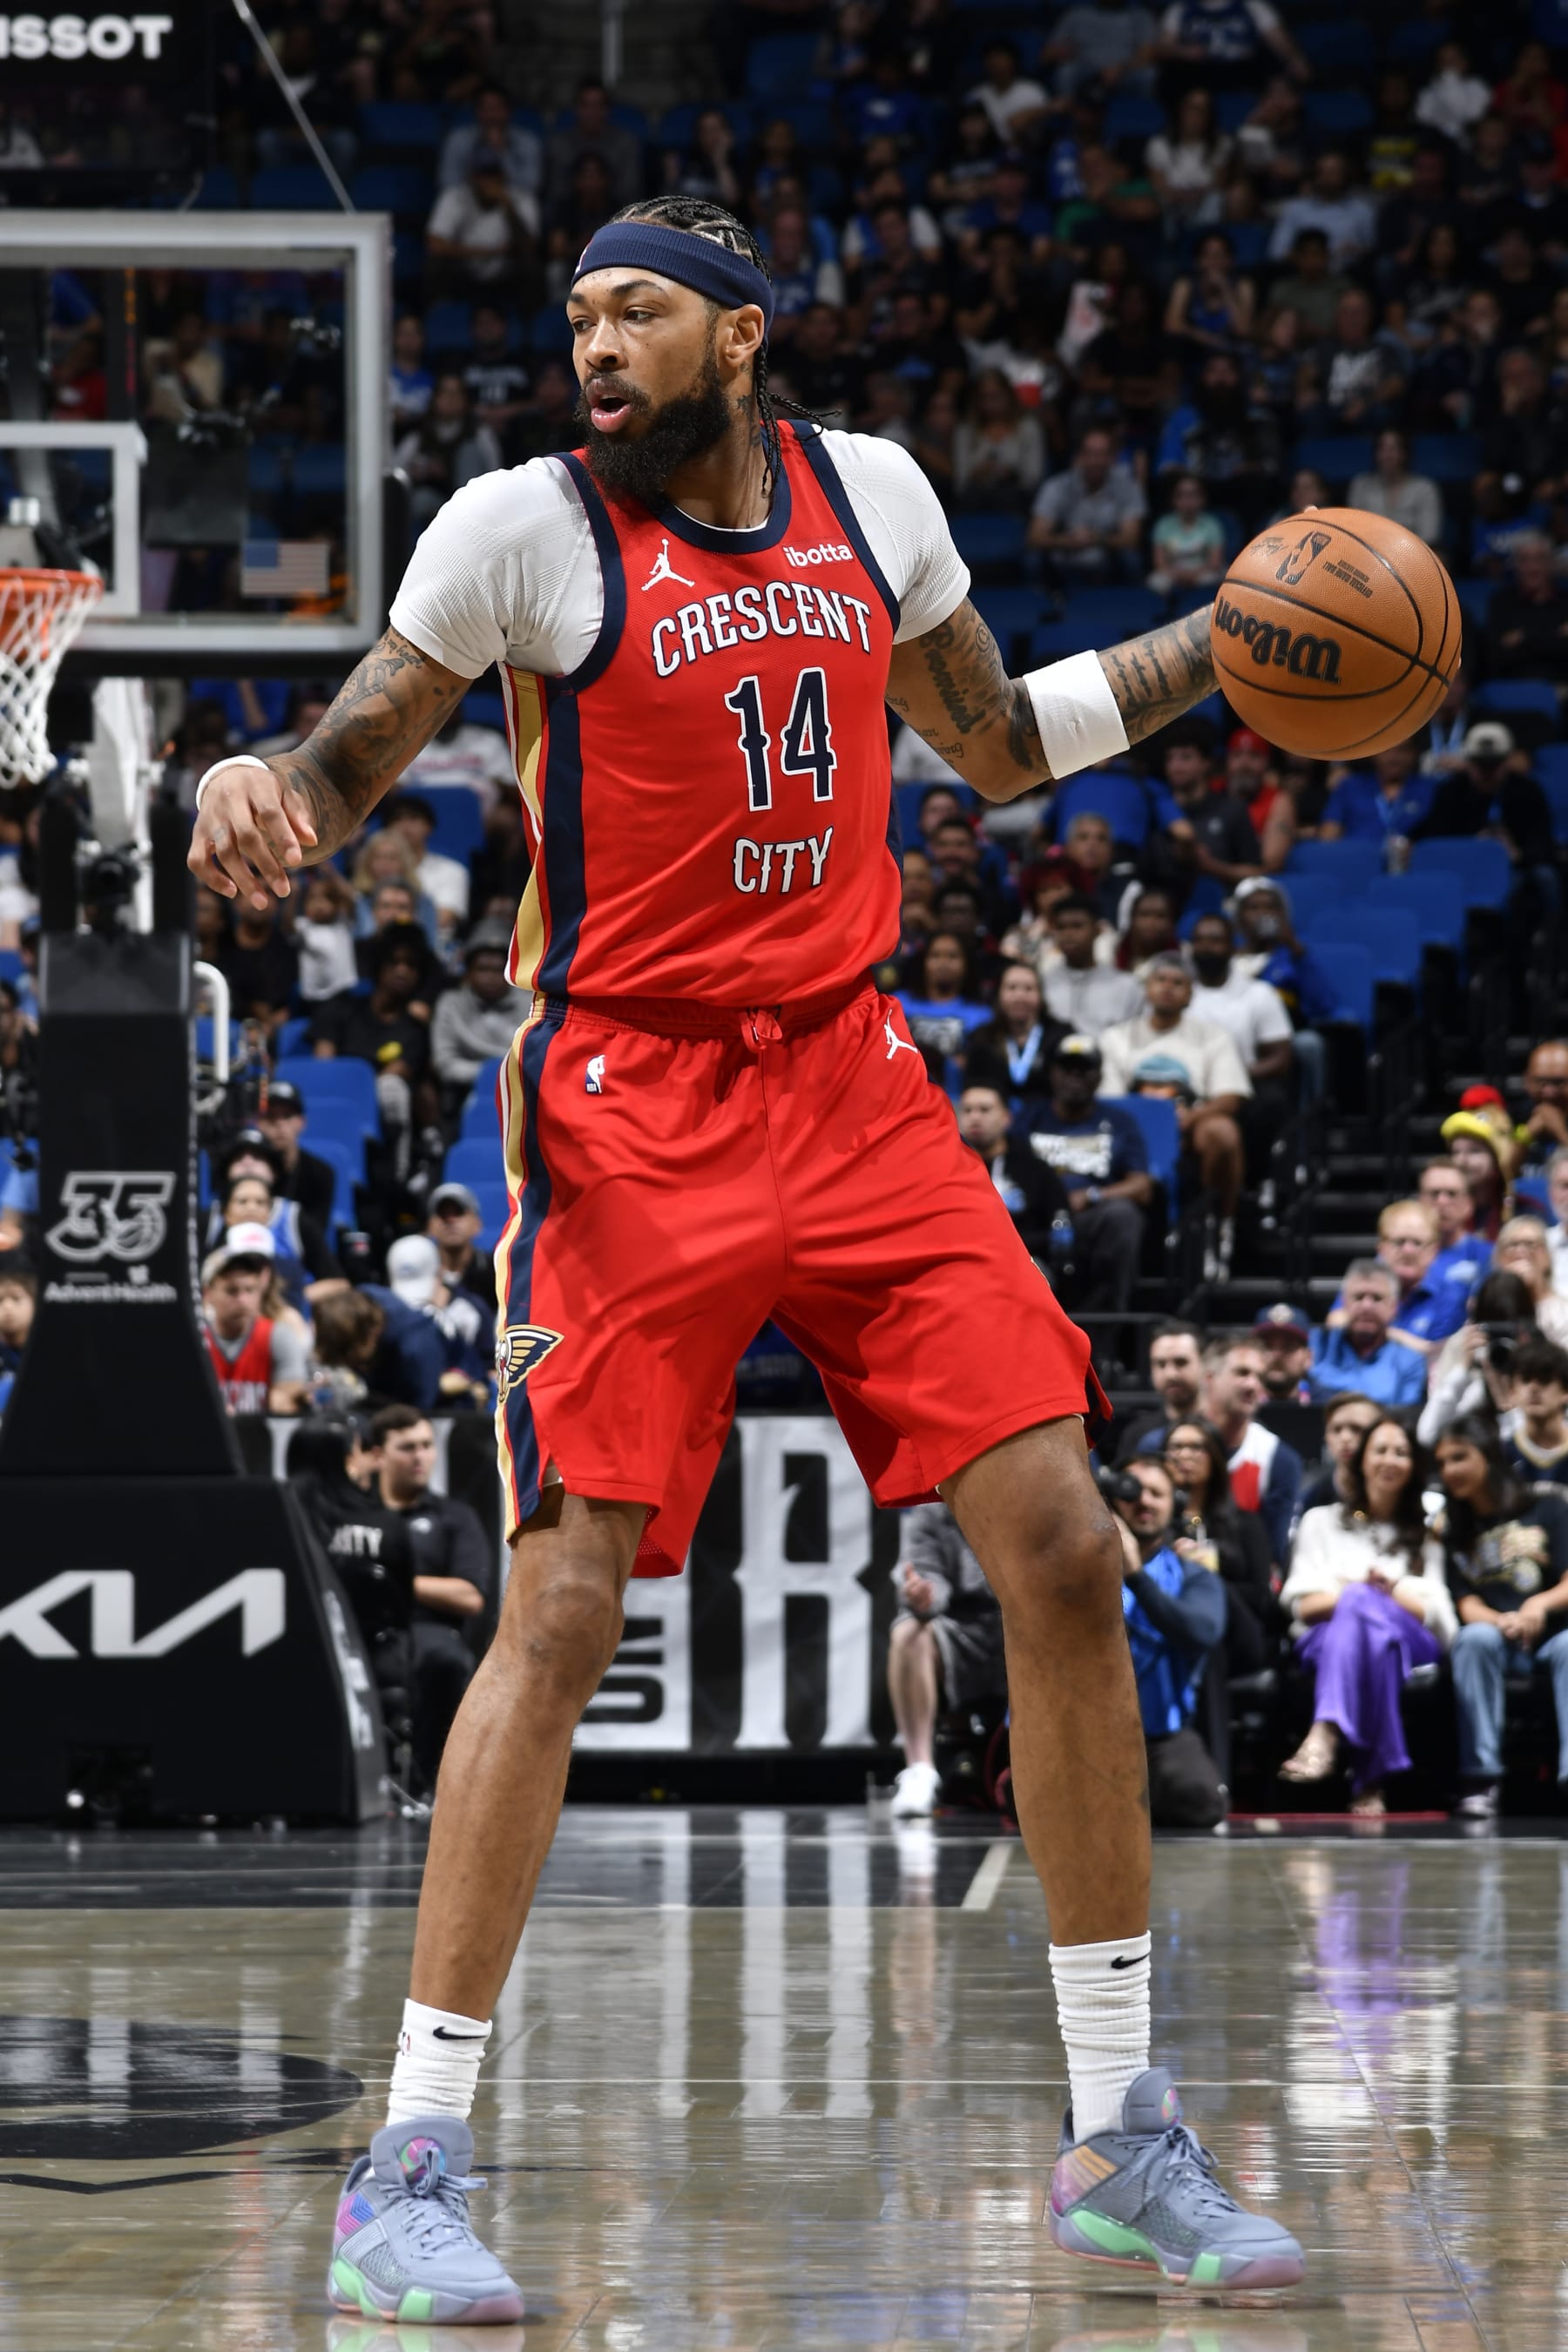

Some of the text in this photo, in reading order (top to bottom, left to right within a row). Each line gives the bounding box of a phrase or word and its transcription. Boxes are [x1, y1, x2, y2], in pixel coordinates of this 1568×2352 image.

[782, 543, 854, 568] ibotta
[651, 580, 871, 678] CRESCENT
[1214, 596, 1342, 684] Wilson
[724, 666, 838, 813] 14
[733, 825, 834, 895] CITY
[45, 1170, 177, 1261] 35
[45, 1281, 177, 1301] AdventHealth
[0, 1567, 286, 1659] KIA
